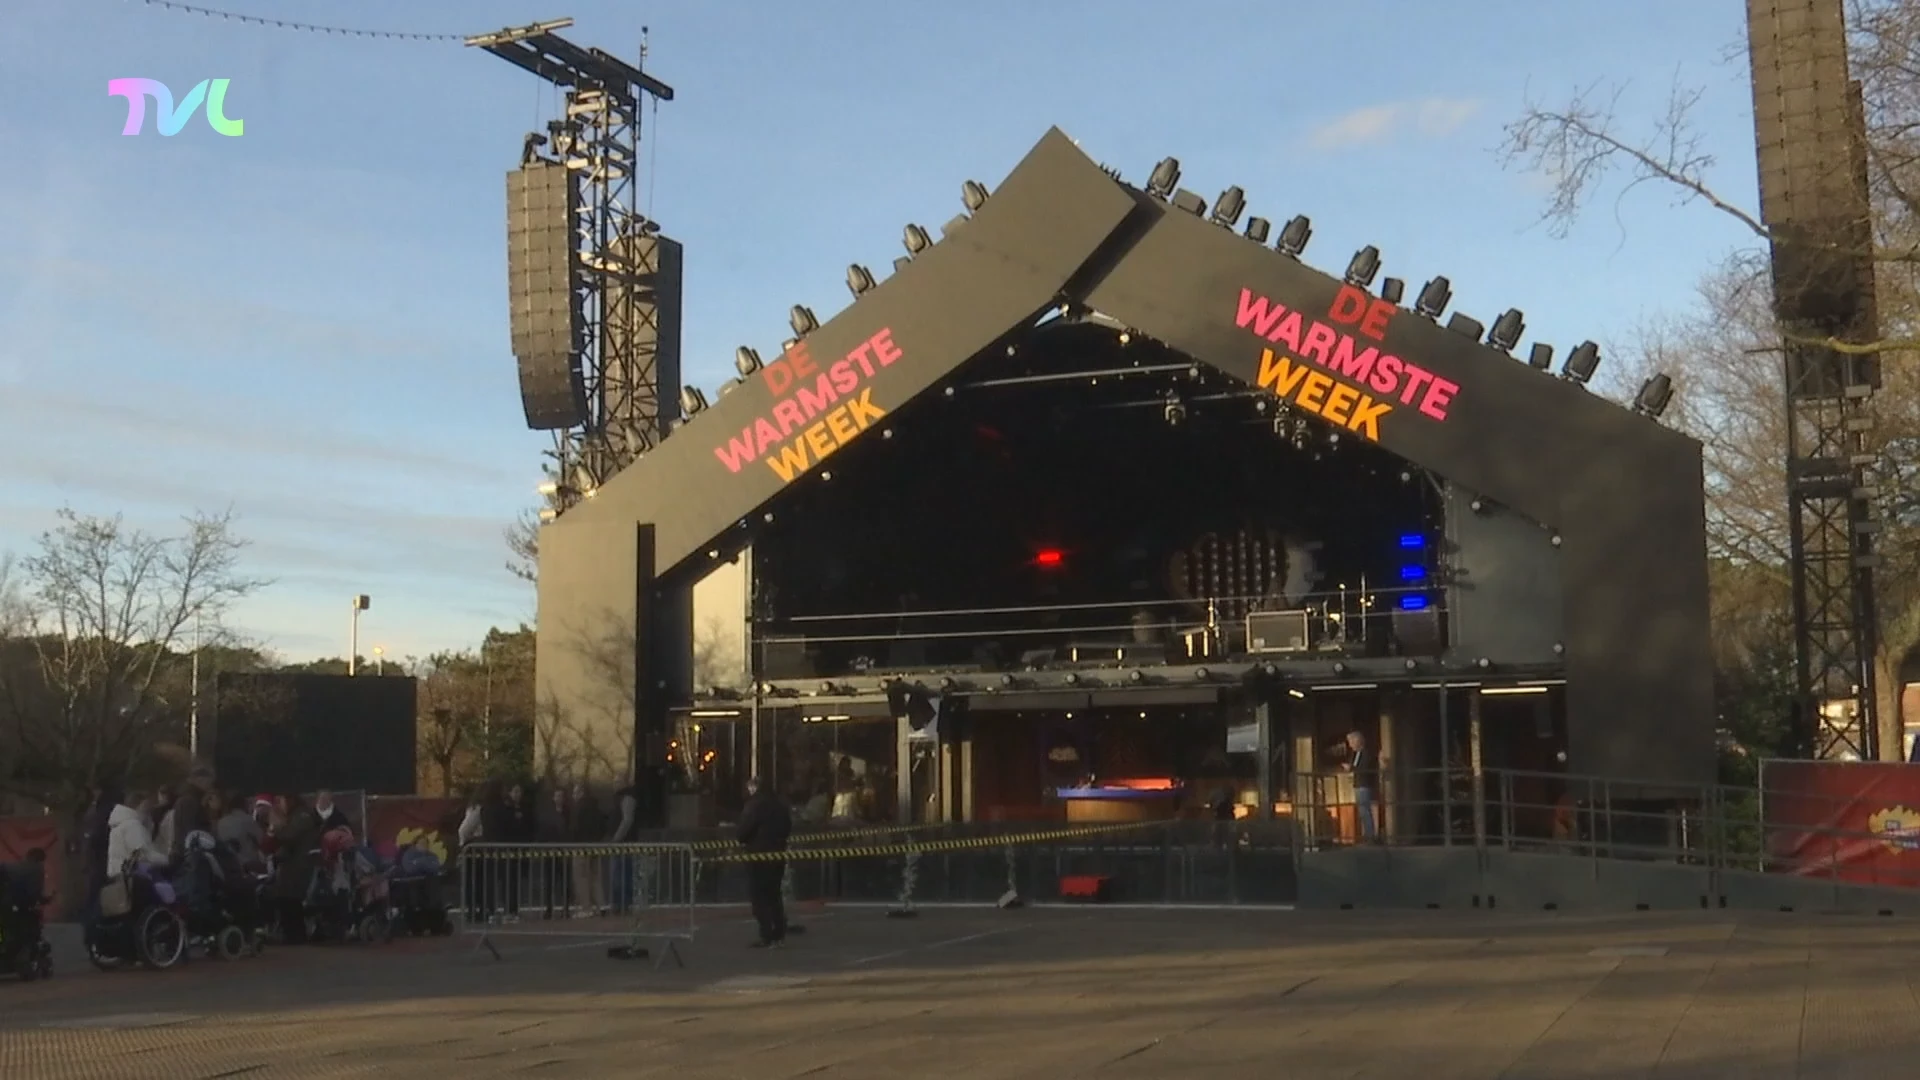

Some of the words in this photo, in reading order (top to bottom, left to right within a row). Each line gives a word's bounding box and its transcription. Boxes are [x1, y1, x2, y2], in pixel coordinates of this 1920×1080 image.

[1236, 287, 1460, 421] WARMSTE
[1328, 284, 1396, 340] DE
[714, 327, 903, 473] WARMSTE
[761, 341, 818, 397] DE
[1257, 348, 1392, 442] WEEK
[766, 387, 886, 482] WEEK
